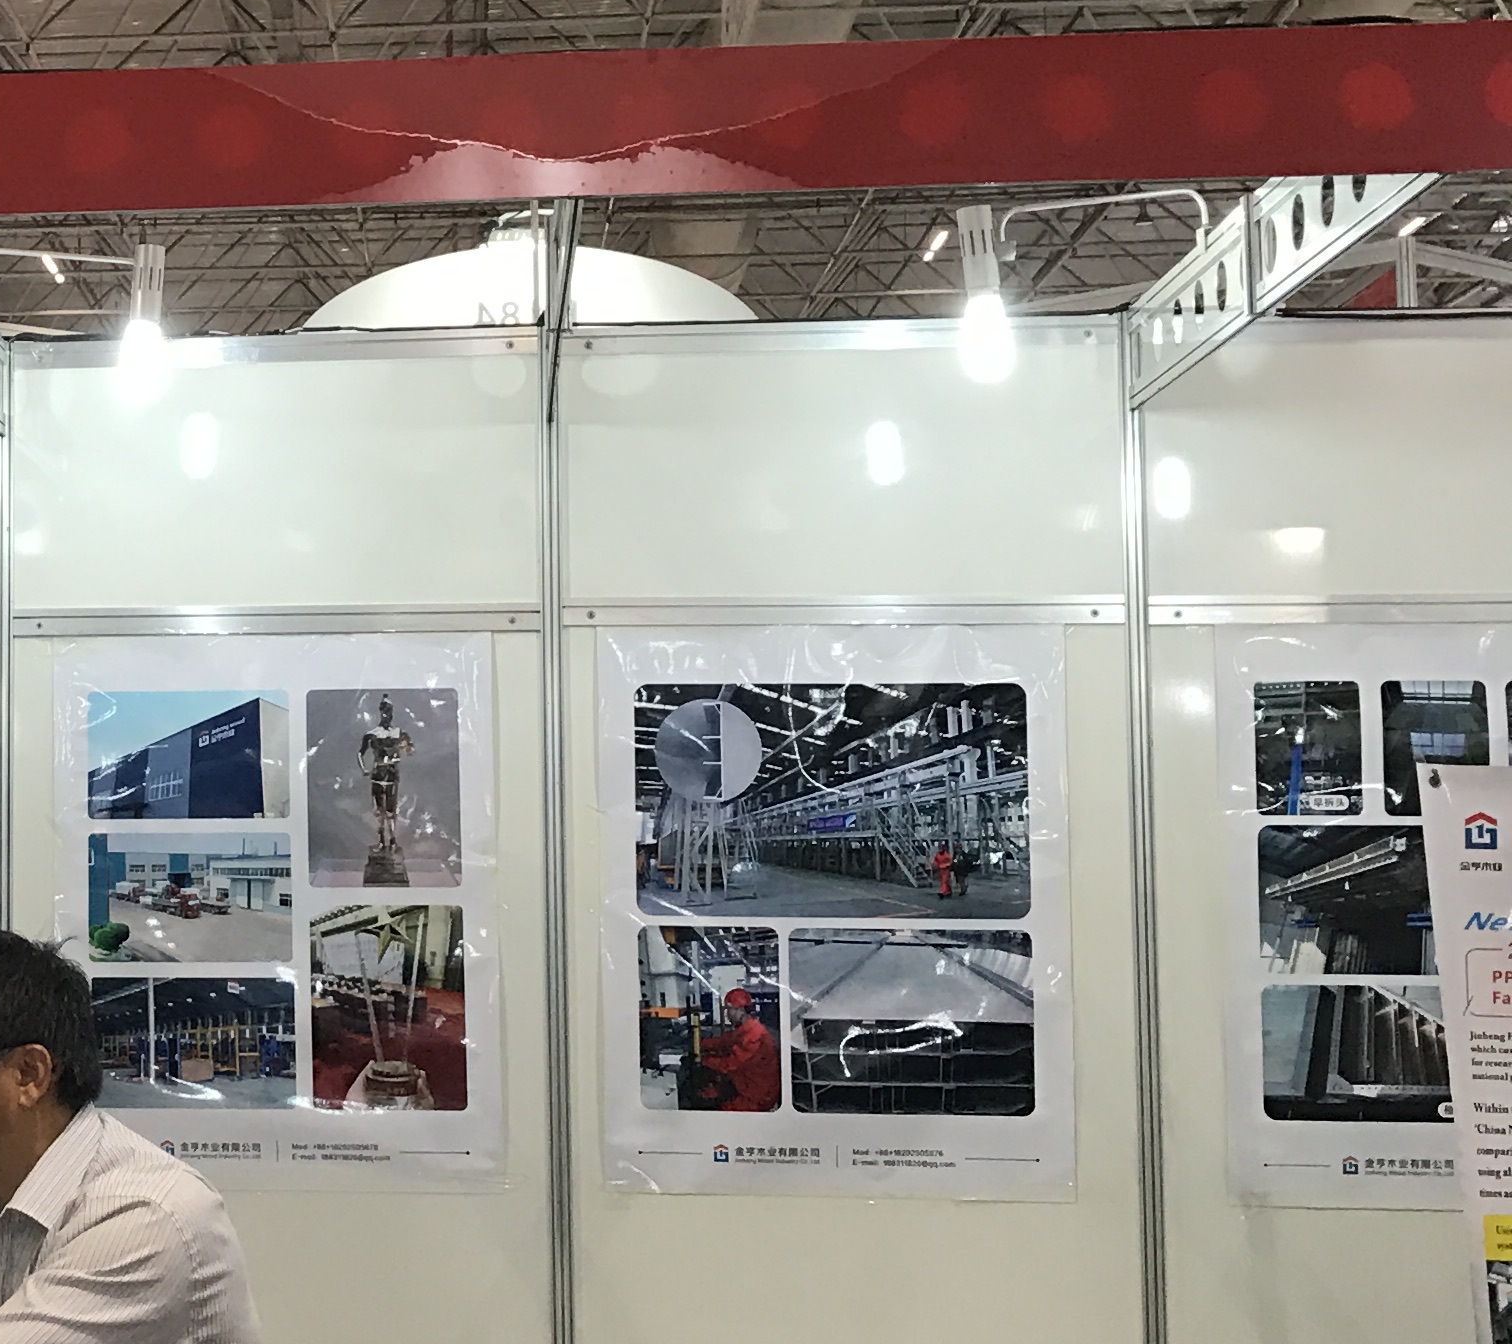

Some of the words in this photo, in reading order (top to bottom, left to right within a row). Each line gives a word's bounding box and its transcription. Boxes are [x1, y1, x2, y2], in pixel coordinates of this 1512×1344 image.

[1473, 1102, 1509, 1113] Within
[734, 1146, 821, 1157] 金亨木业有限公司
